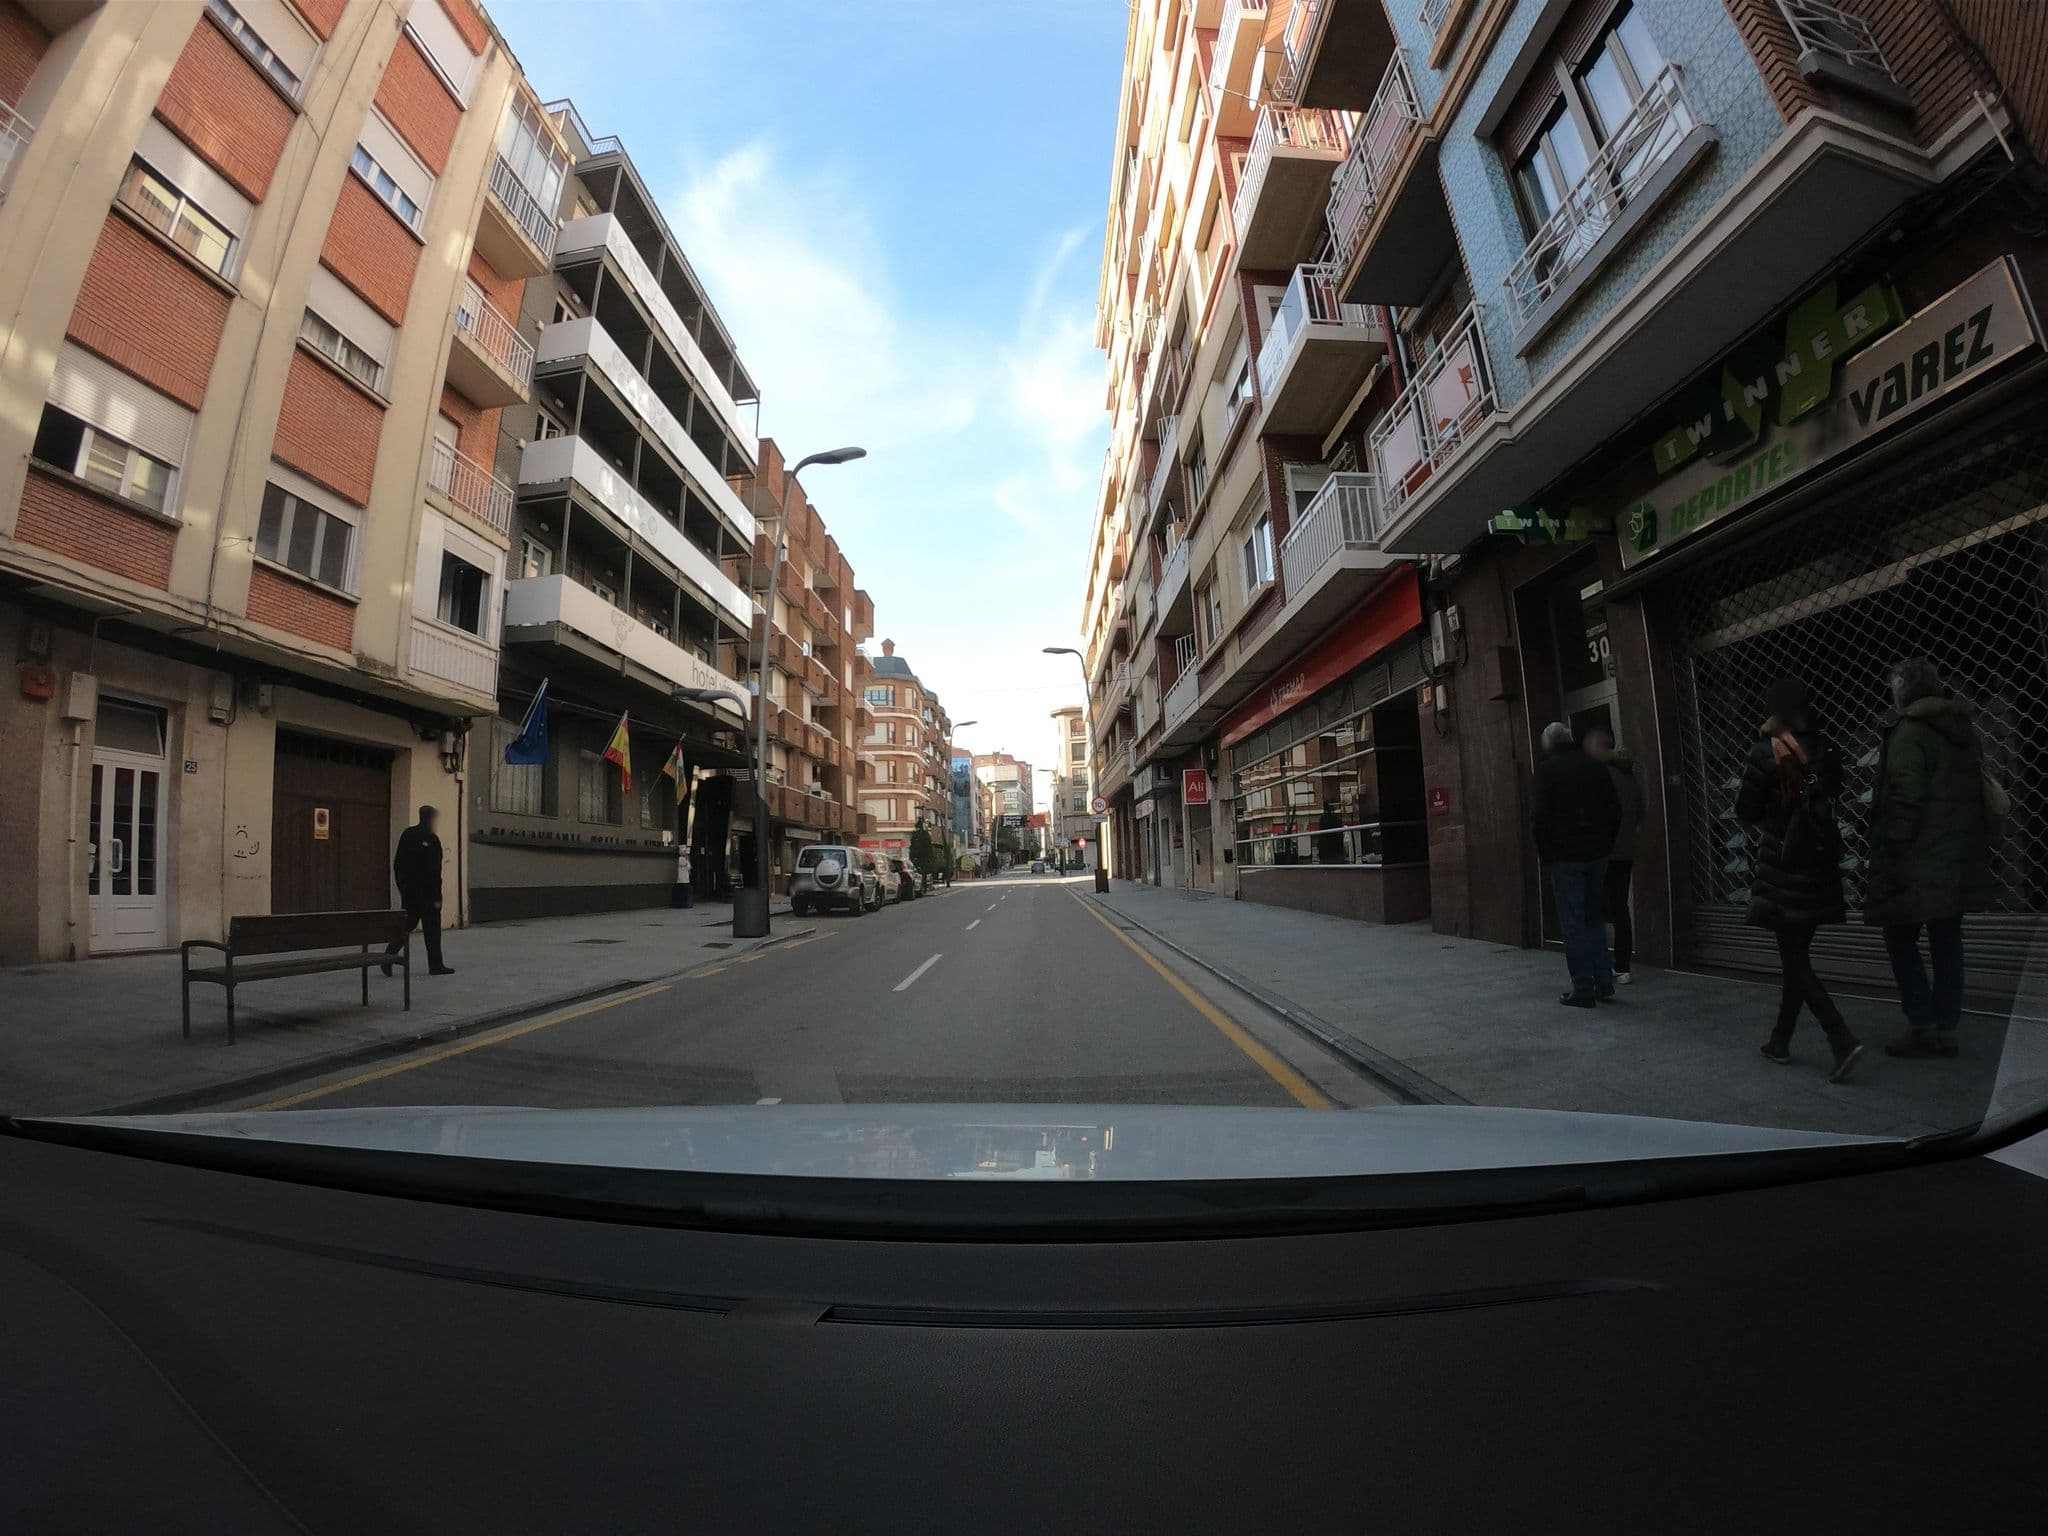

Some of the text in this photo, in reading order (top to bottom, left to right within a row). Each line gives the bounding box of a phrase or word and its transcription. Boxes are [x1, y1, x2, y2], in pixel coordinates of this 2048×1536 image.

[1662, 303, 1873, 462] TWINNER
[1505, 517, 1601, 528] TWINN
[1588, 636, 1610, 663] 30
